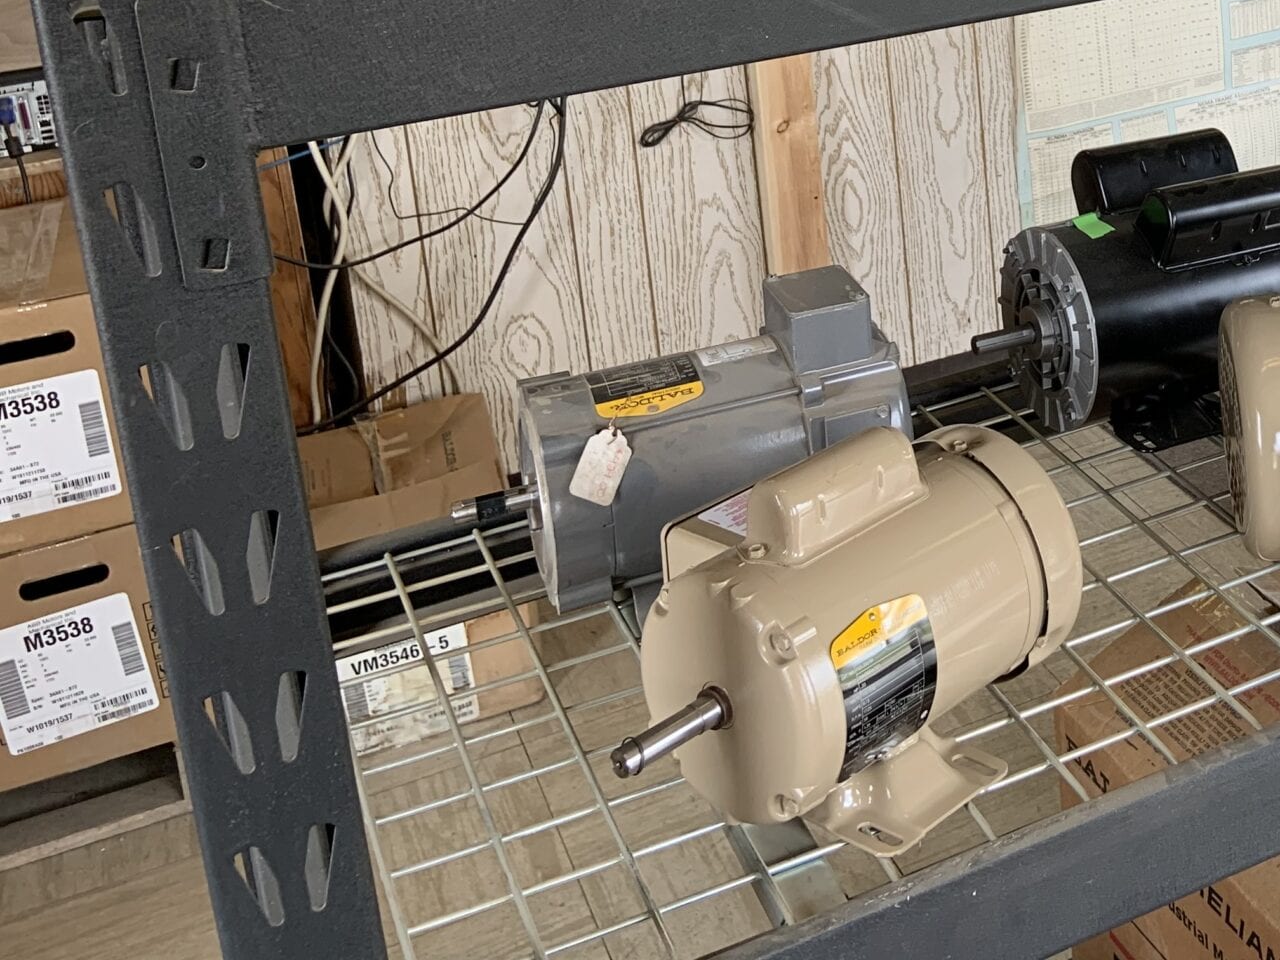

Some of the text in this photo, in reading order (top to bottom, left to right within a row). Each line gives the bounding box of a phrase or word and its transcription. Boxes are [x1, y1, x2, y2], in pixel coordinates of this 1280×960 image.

[612, 387, 695, 411] BALDOR
[0, 490, 32, 505] 19/1537
[23, 616, 94, 653] M3538
[836, 629, 879, 657] BALDOR
[89, 692, 100, 700] USA
[26, 713, 74, 735] W1019/1537
[1065, 734, 1110, 794] BAL
[1168, 901, 1209, 949] ustrial
